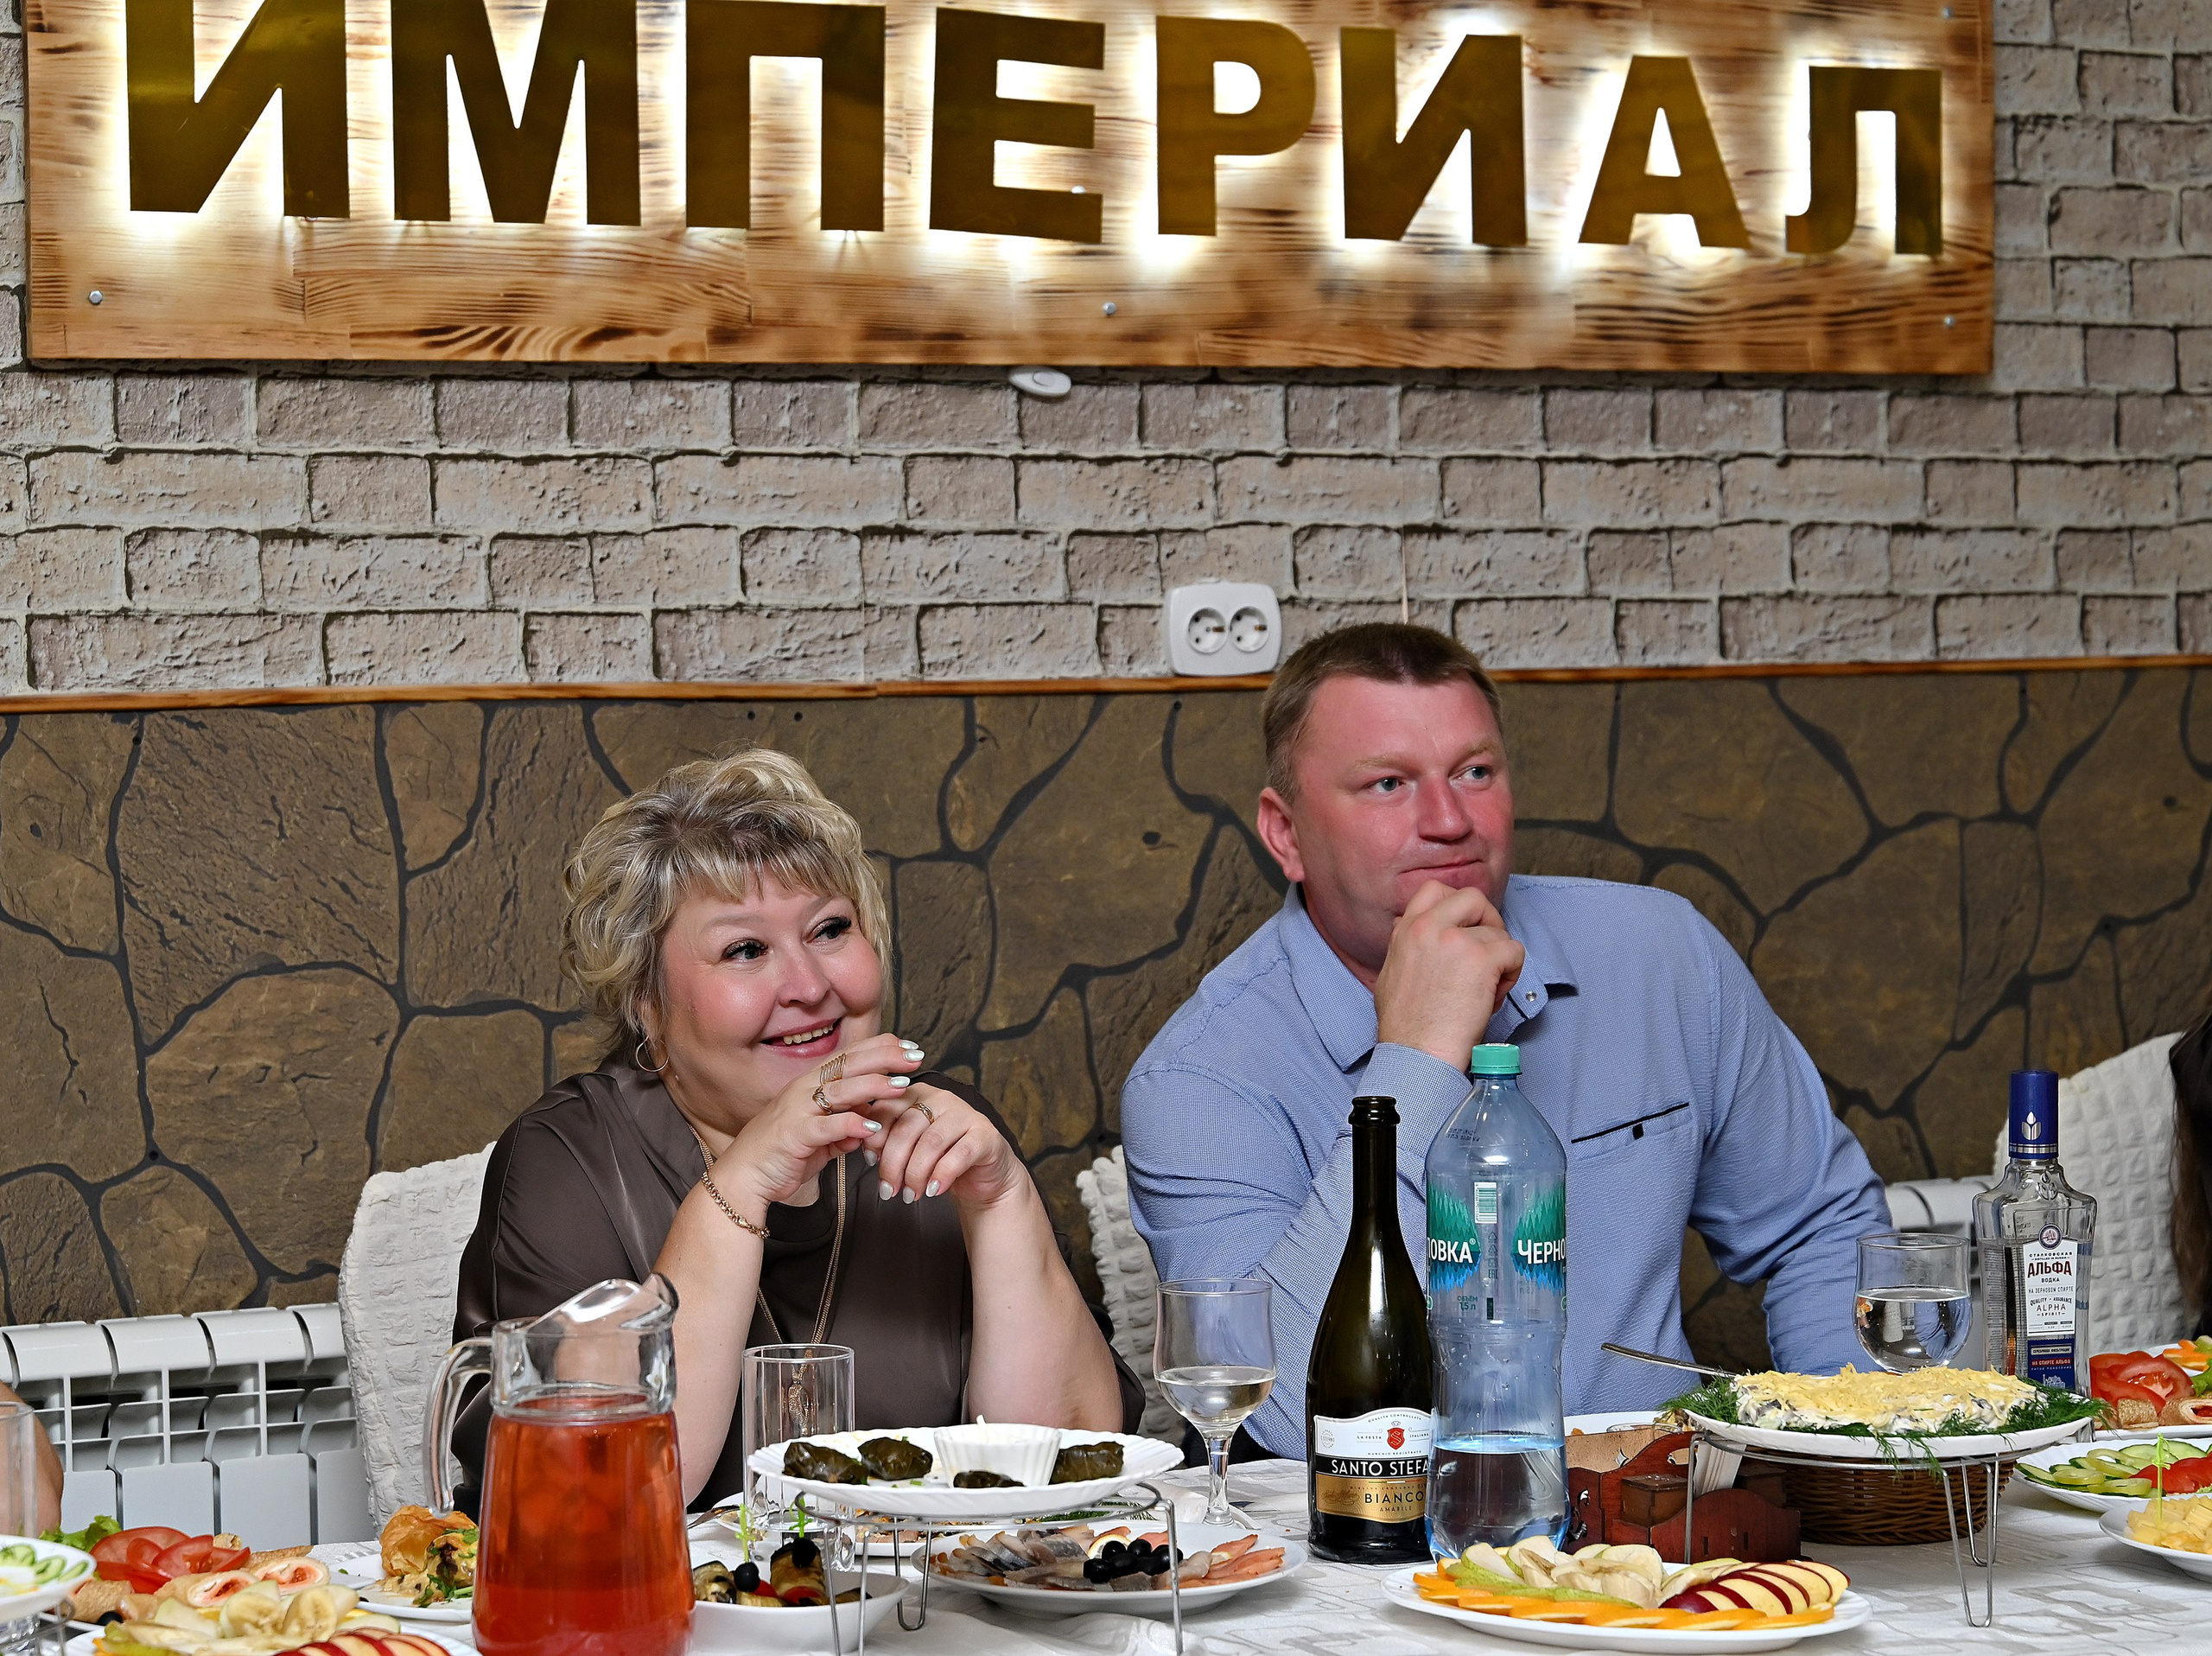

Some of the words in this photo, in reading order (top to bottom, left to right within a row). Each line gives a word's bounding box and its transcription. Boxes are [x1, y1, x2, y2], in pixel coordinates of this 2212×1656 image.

[130, 0, 1942, 257] ИМПЕРИАЛ
[1518, 1238, 1567, 1264] ЧЕРНО
[2027, 1260, 2072, 1278] АЛЬФА
[2030, 1297, 2048, 1306] QUALITY
[2036, 1303, 2066, 1312] ALPHA
[1332, 1459, 1382, 1476] SANTO
[1364, 1491, 1424, 1504] BIANCO
